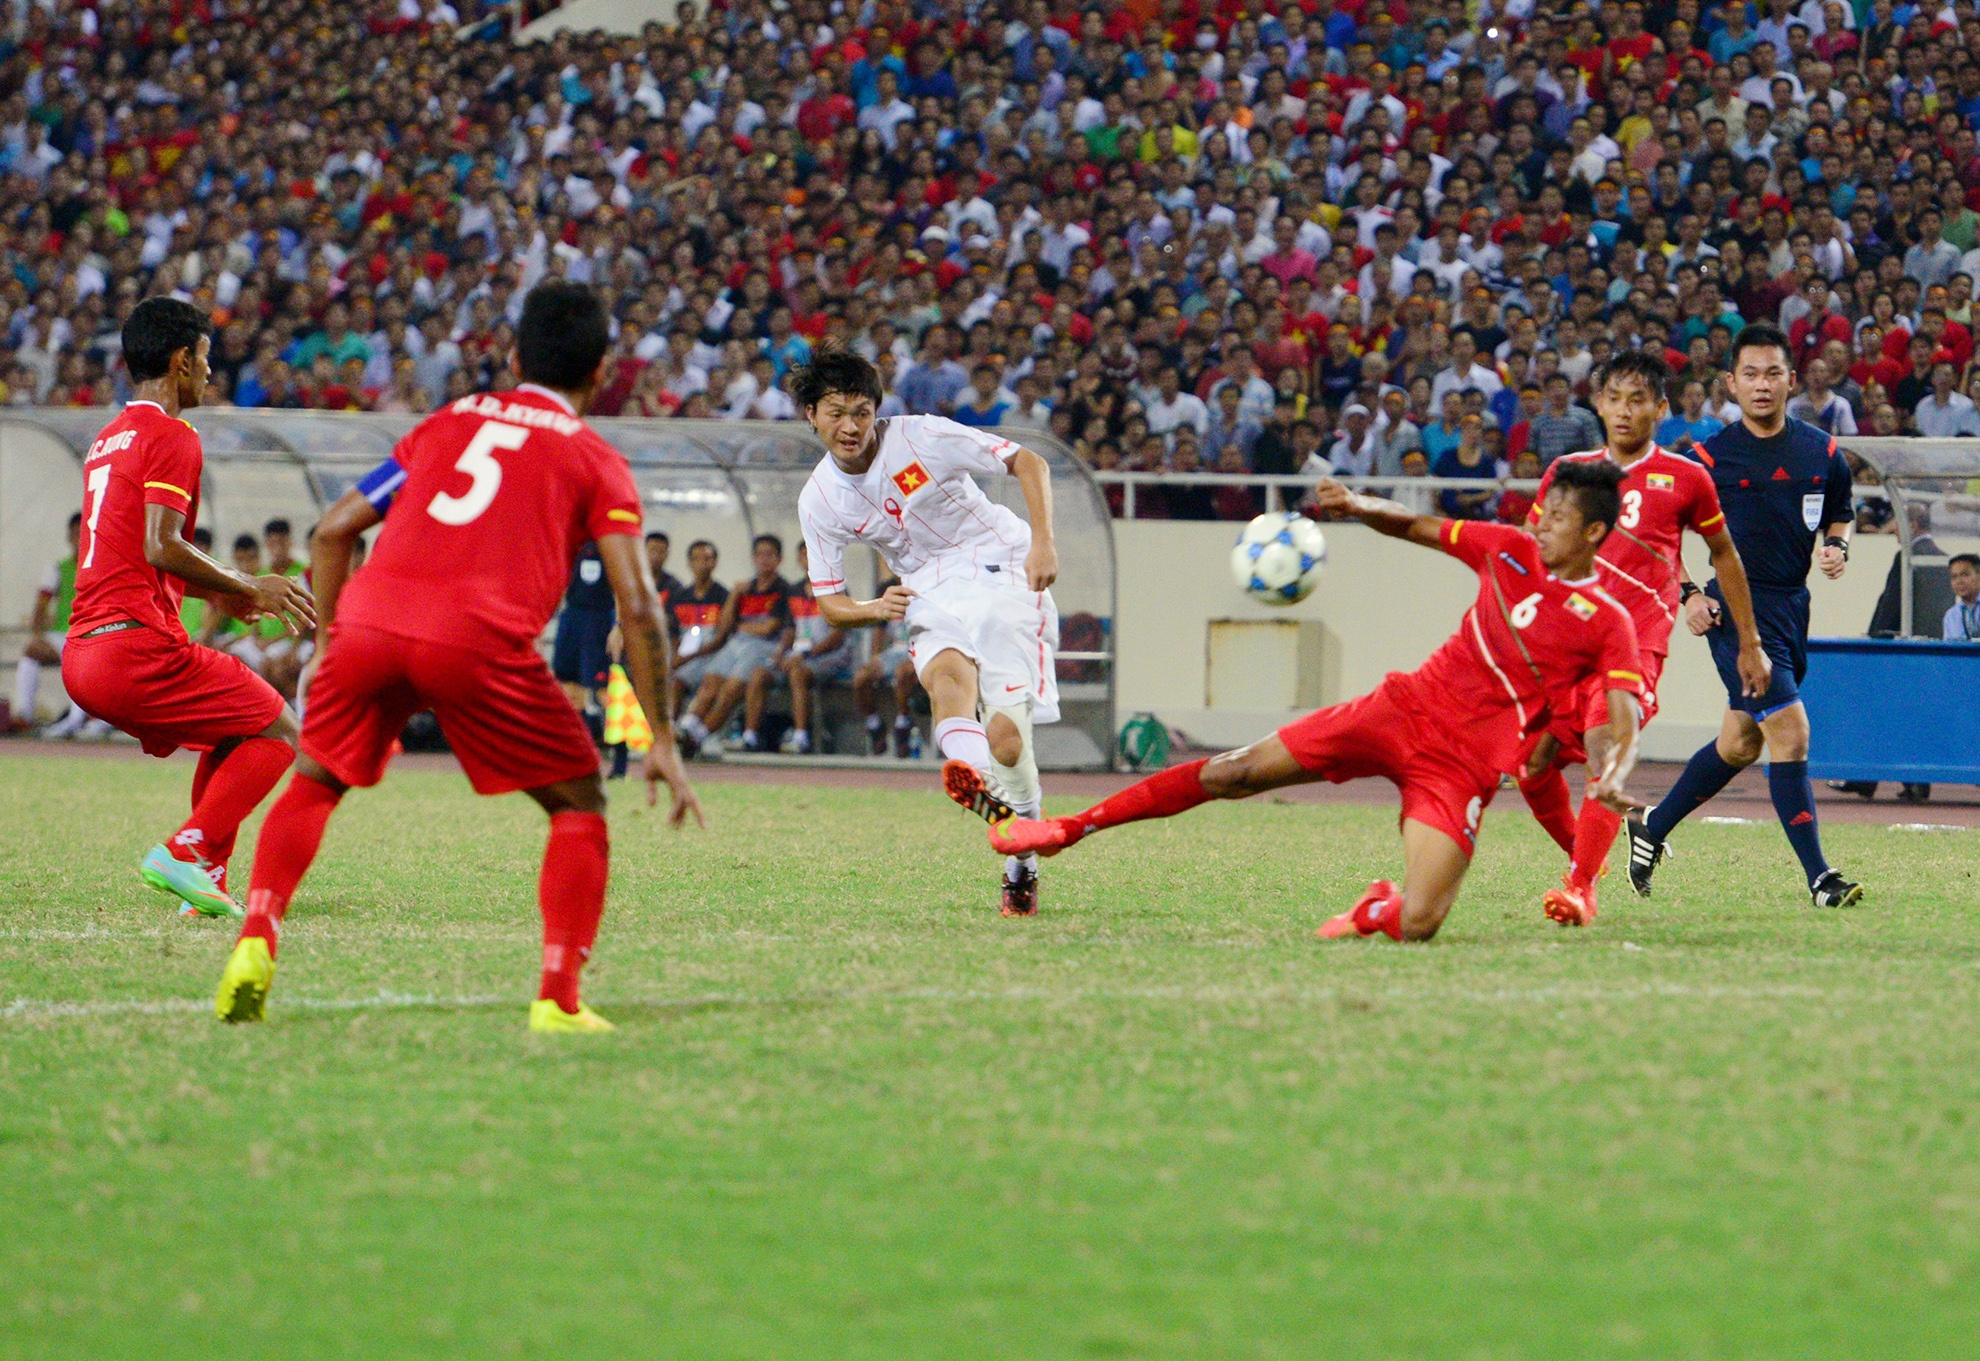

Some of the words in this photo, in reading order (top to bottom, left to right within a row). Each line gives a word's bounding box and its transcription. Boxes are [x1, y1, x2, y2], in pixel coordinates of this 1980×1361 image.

[84, 430, 138, 464] .C.AUNG
[426, 420, 531, 526] 5
[82, 463, 112, 569] 7
[1619, 489, 1643, 529] 3
[1510, 592, 1544, 629] 6
